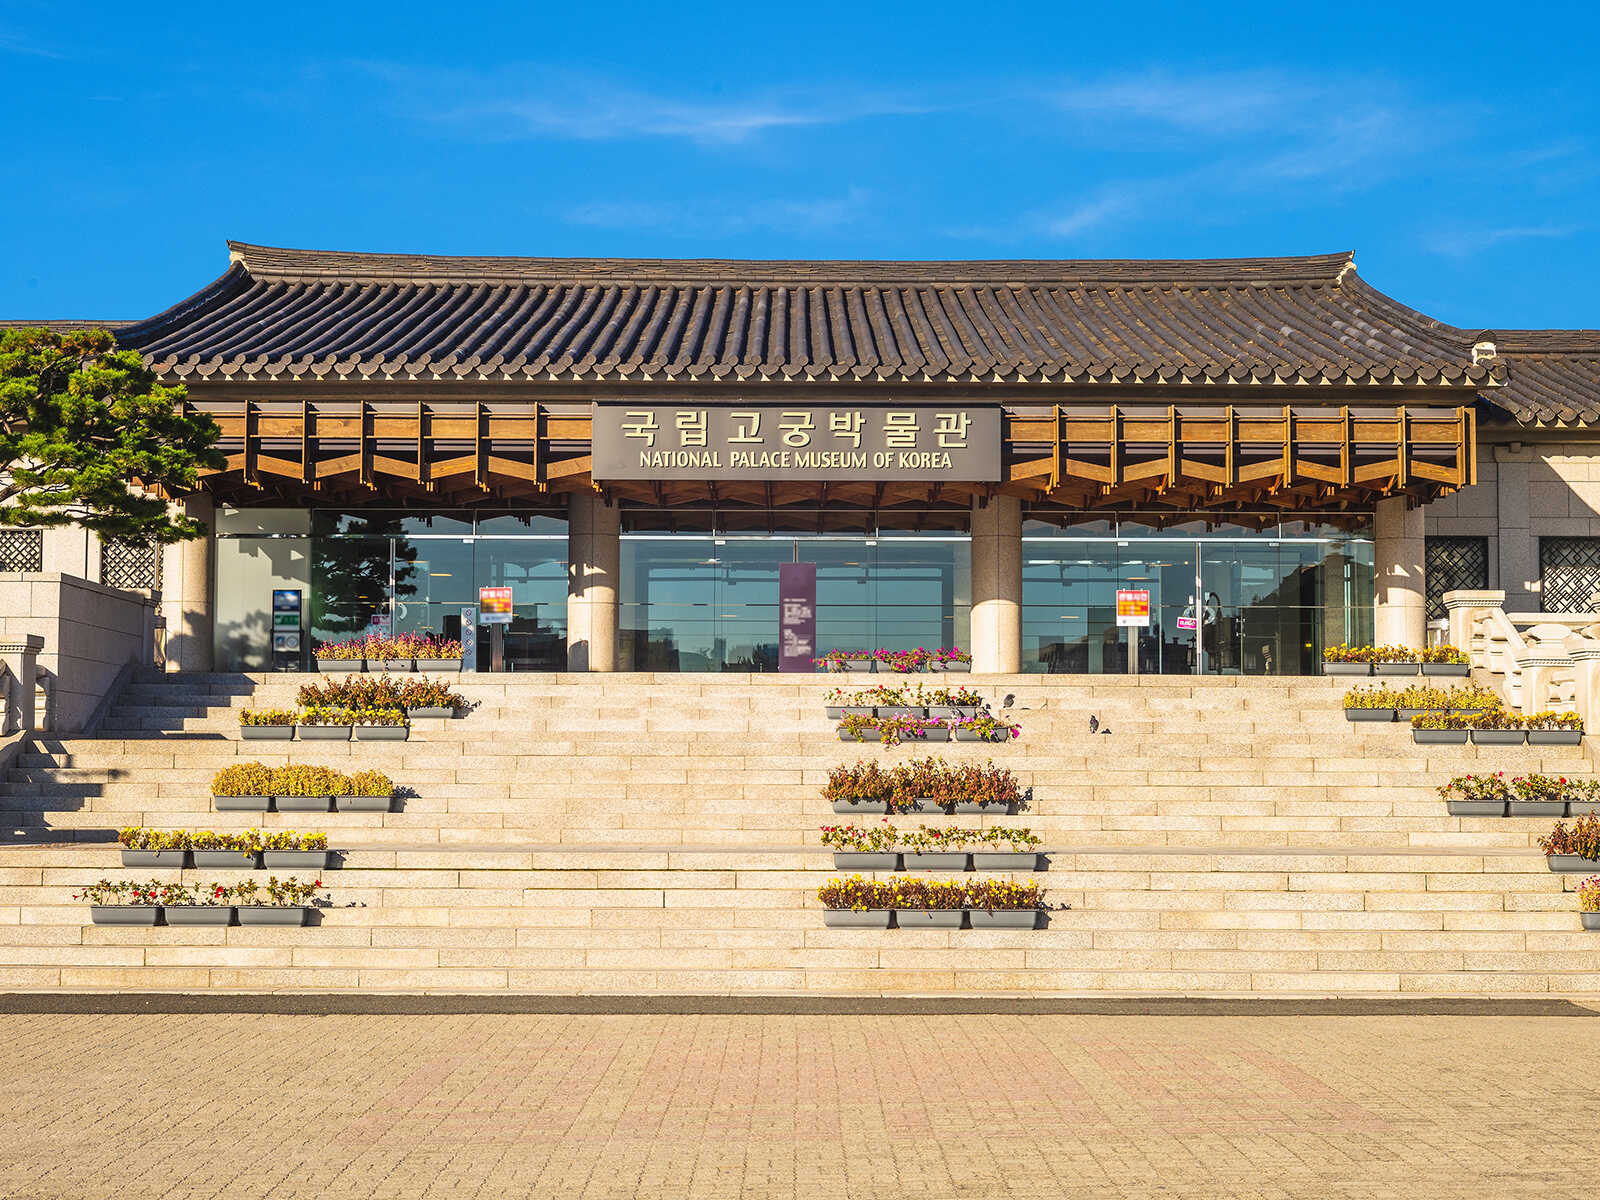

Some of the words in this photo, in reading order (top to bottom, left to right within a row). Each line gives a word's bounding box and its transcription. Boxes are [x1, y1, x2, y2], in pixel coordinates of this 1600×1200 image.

[639, 450, 722, 468] NATIONAL
[730, 450, 791, 468] PALACE
[794, 451, 868, 469] MUSEUM
[873, 451, 895, 468] OF
[899, 451, 953, 469] KOREA
